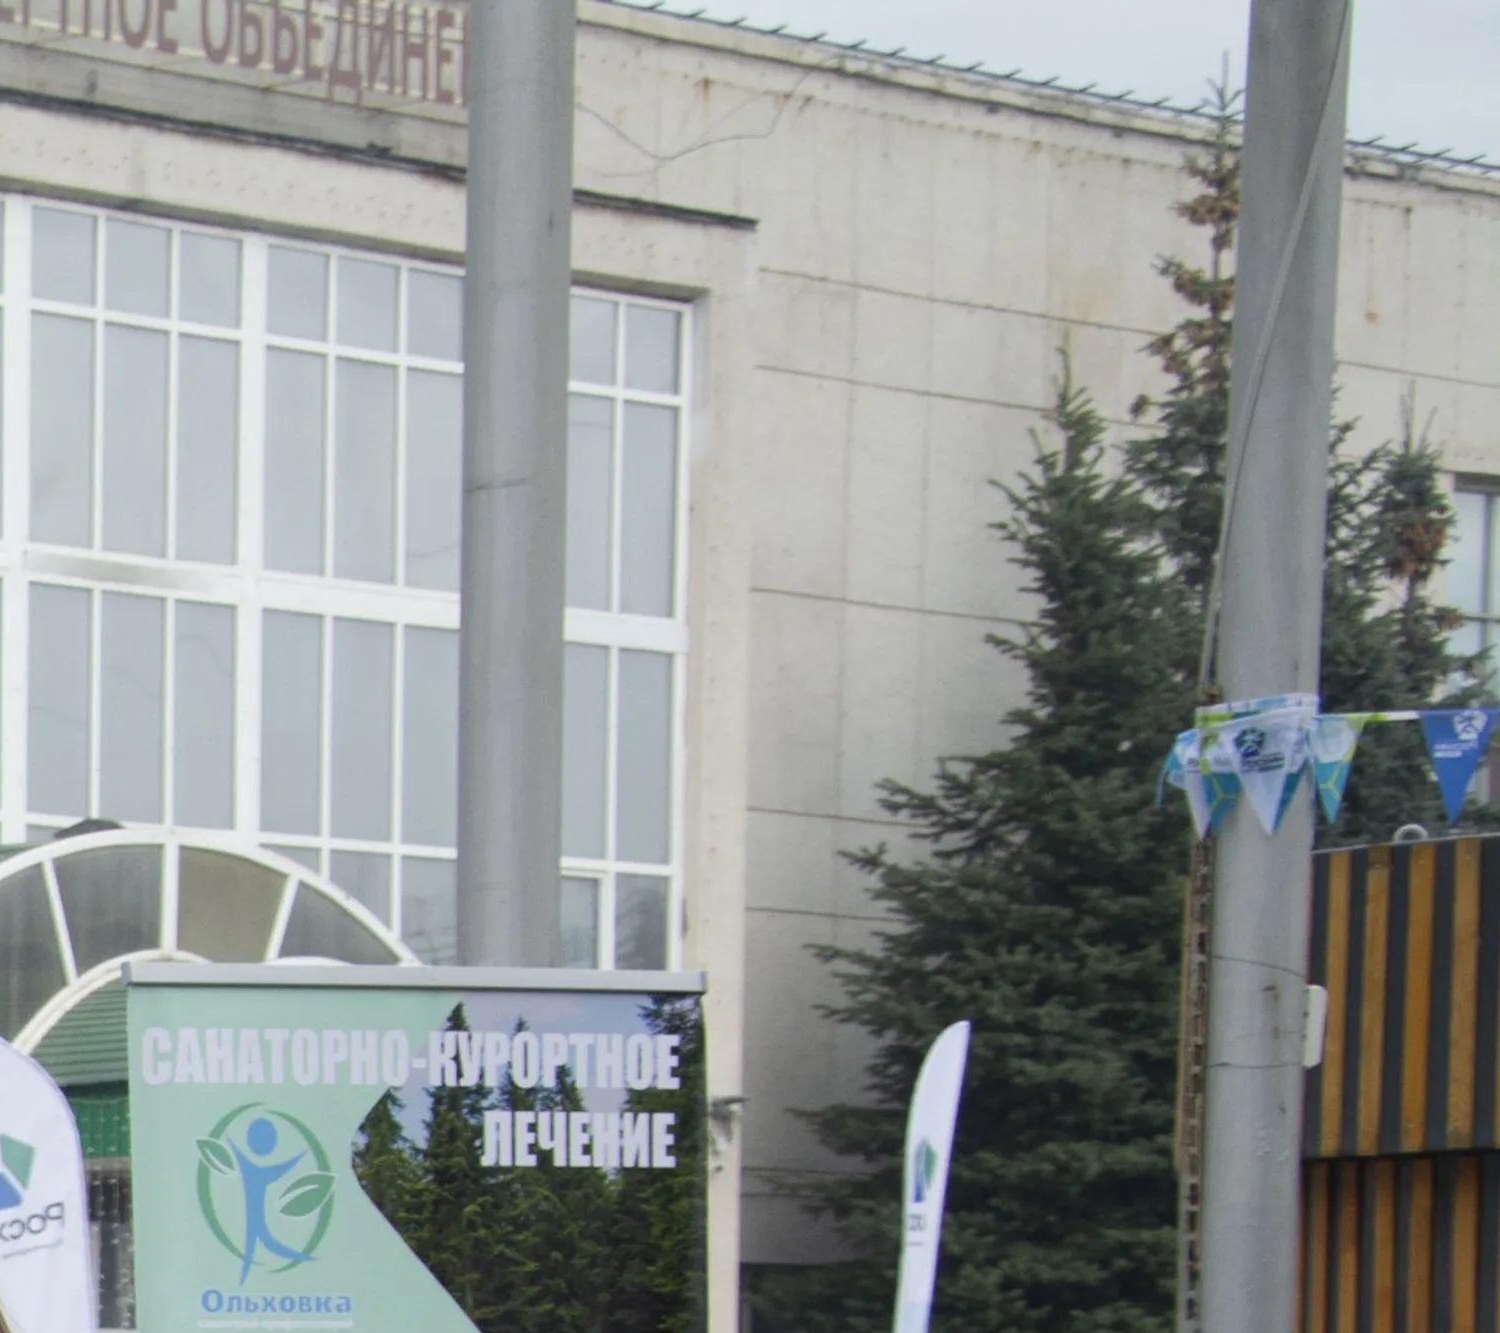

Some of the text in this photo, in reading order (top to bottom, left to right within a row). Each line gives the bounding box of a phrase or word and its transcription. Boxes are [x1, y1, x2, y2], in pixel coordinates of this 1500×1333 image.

[142, 1028, 680, 1091] САНАТОРНО-КУРОРТНОЕ
[481, 1111, 676, 1169] ЛЕЧЕНИЕ
[201, 1289, 352, 1315] Ольховка
